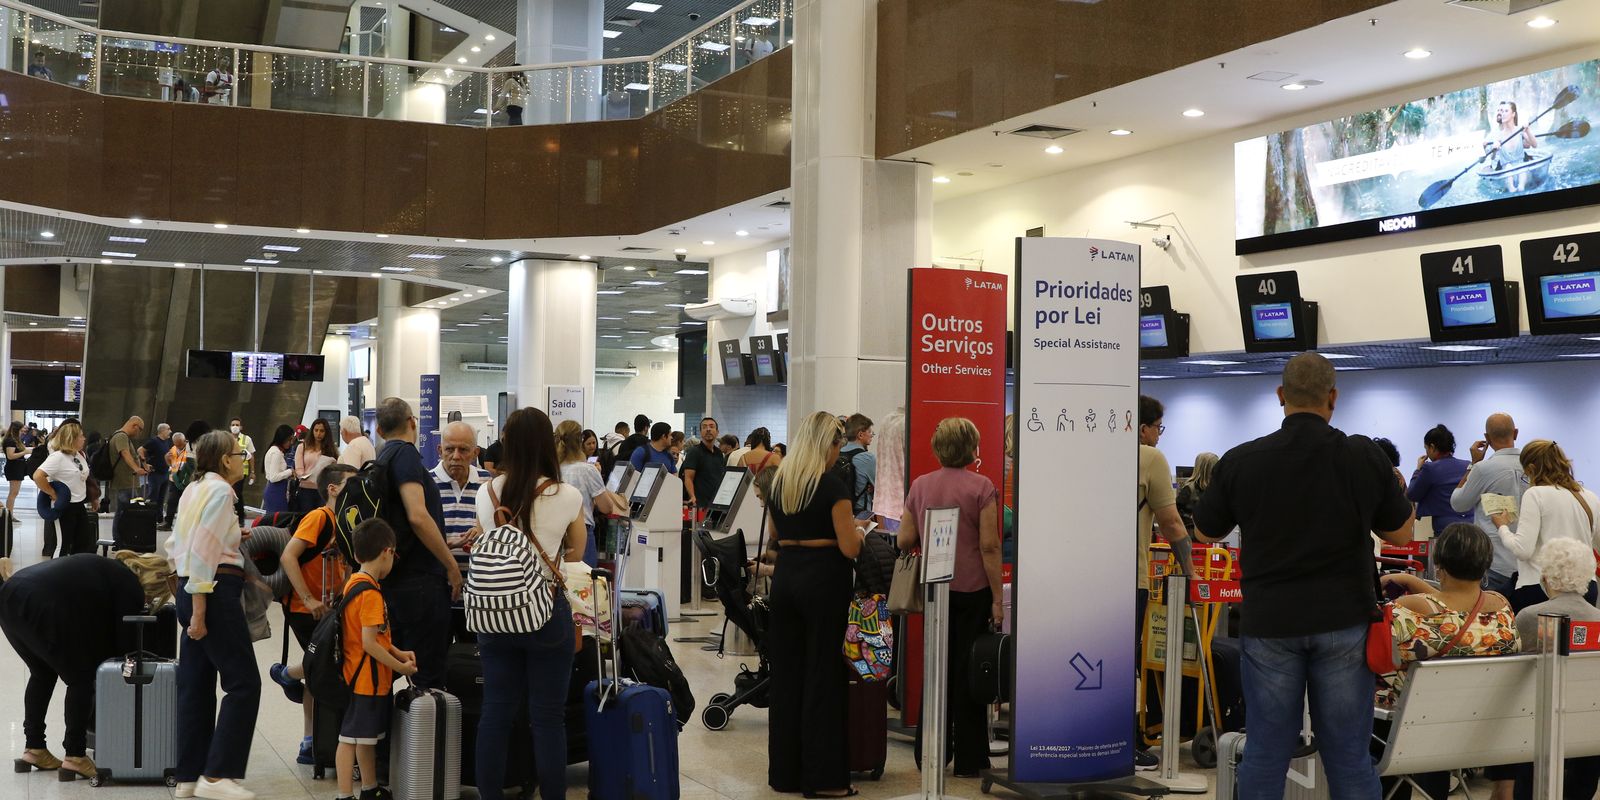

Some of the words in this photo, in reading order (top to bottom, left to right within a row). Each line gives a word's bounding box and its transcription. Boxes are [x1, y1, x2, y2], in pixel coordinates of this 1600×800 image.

[1379, 216, 1416, 233] NEOOH
[1101, 250, 1134, 263] LATAM
[1553, 242, 1580, 263] 42
[1452, 255, 1474, 275] 41
[974, 281, 1003, 291] LATAM
[1035, 280, 1133, 303] Prioridades
[1258, 278, 1277, 296] 40
[1560, 282, 1591, 291] LATAM
[1456, 293, 1482, 301] LATAM
[921, 313, 983, 334] Outros
[1035, 309, 1069, 329] por
[1075, 307, 1101, 325] Lei
[725, 344, 733, 354] 32
[757, 339, 765, 349] 33
[921, 334, 993, 359] Serviços
[1034, 338, 1071, 351] Special
[1074, 338, 1121, 350] Assistance
[921, 363, 952, 374] Other
[955, 364, 992, 376] Services
[1220, 588, 1242, 598] HotM
